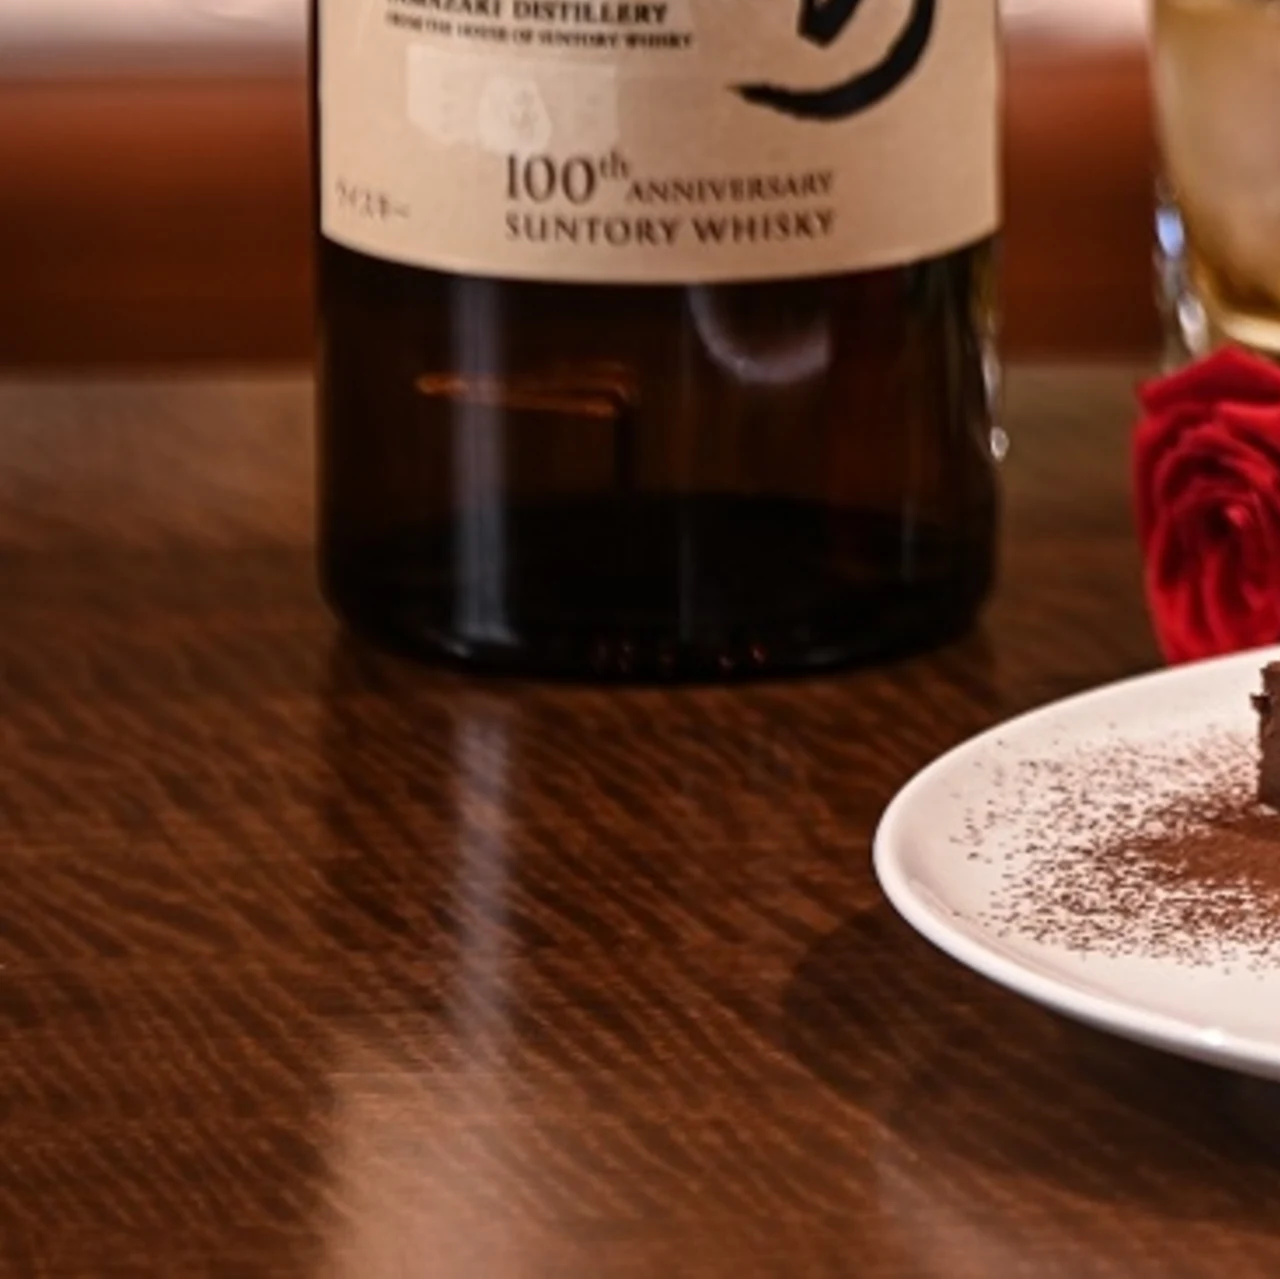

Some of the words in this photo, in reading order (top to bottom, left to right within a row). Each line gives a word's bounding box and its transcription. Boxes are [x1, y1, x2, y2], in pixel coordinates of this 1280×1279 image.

[506, 148, 630, 206] 100th
[626, 171, 833, 204] ANNIVERSARY
[505, 211, 680, 246] SUNTORY
[691, 210, 834, 244] WHISKY
